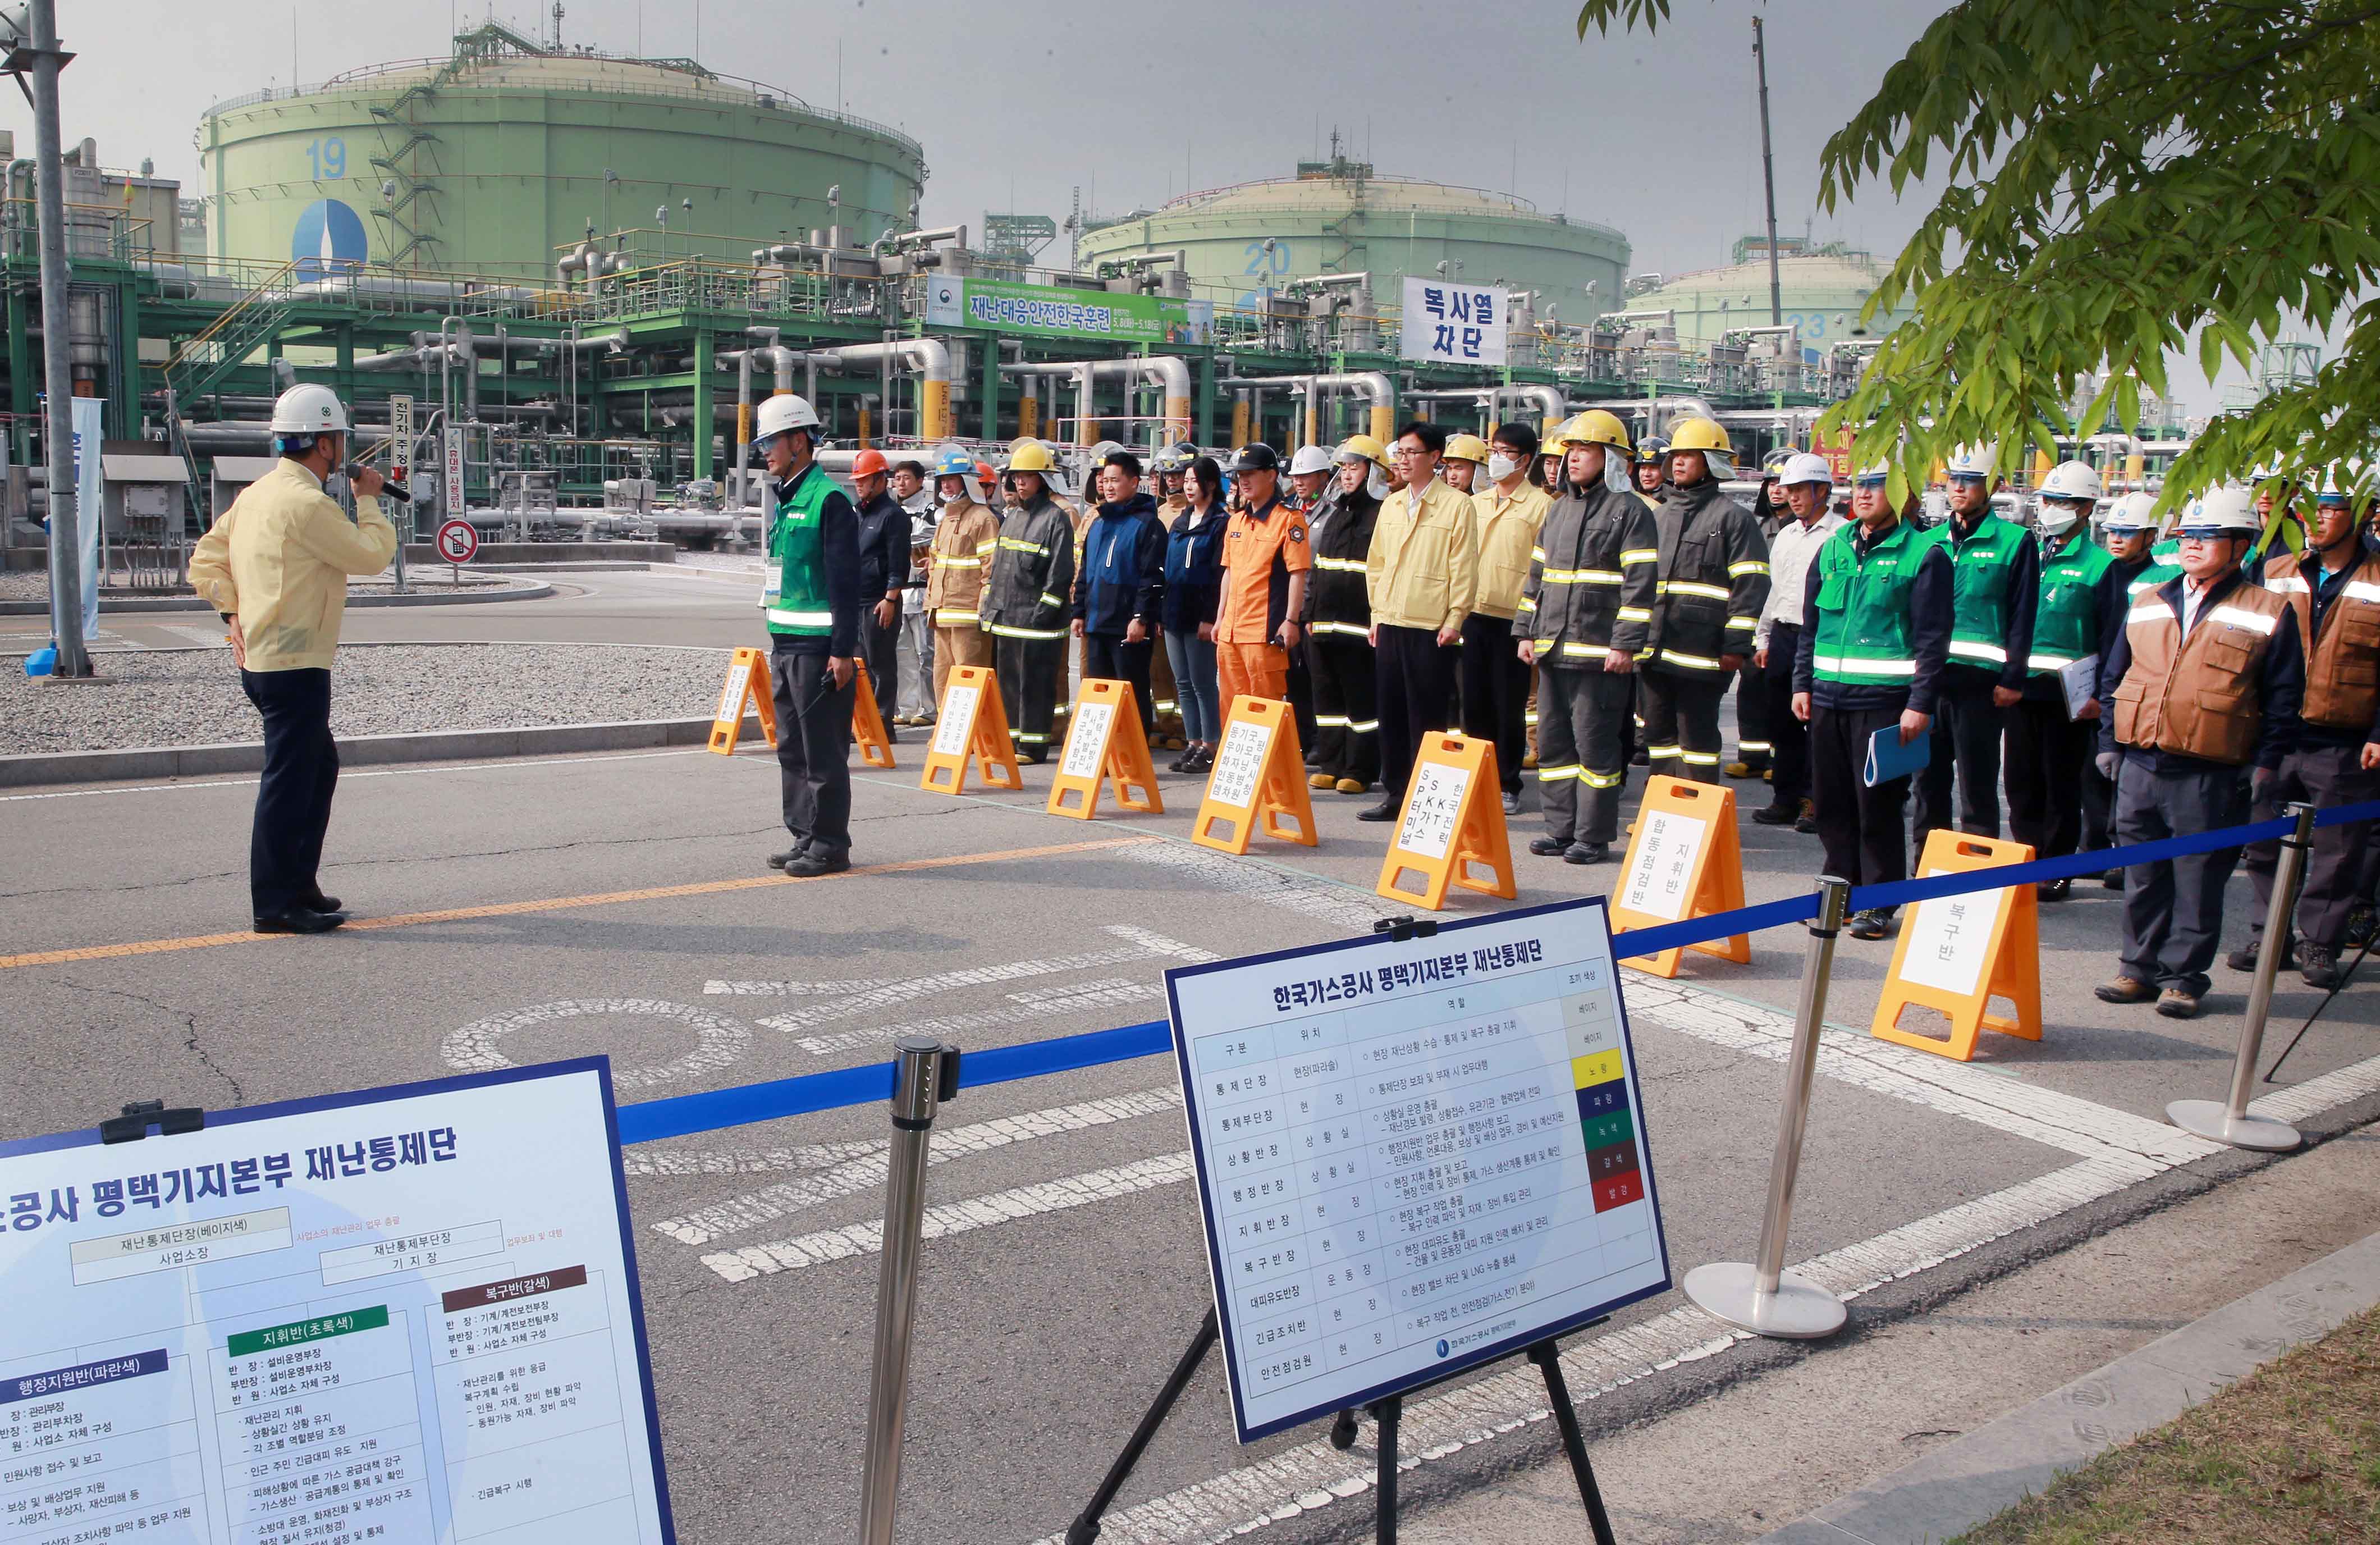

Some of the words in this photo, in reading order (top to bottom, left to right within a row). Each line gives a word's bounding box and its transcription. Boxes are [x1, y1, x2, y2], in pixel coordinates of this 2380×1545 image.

[305, 137, 346, 180] 19
[1244, 243, 1291, 276] 20
[970, 295, 1110, 332] 재난대응안전한국훈련
[1425, 287, 1492, 324] 복사열
[1433, 324, 1482, 358] 차단
[1787, 313, 1825, 339] 23
[396, 403, 409, 435] 전기차
[448, 450, 459, 474] 휴대폰
[450, 477, 460, 509] 사용금지
[1221, 729, 1249, 799] 기아자동차
[1231, 730, 1258, 801] 굿모닝병원
[1243, 740, 1265, 796] 평택시청
[1631, 819, 1667, 906] 합동점검반
[1665, 844, 1690, 894] 지휘반
[1938, 903, 1966, 962] 복구반
[1273, 970, 1373, 1011] 한국가스공사
[1377, 952, 1468, 991] 평택기지본부
[1472, 939, 1542, 971] 재난통제단
[1293, 1059, 1338, 1078] 현장(파라솔)
[92, 1153, 292, 1217] 평택기지본부
[305, 1127, 456, 1180] 재난통제단
[121, 1218, 247, 1250] 재난통제단장(베이지색)
[373, 1231, 450, 1255] 재난통제부단장
[159, 1246, 208, 1265] 사업소장
[486, 1276, 550, 1299] 복구반(갈색)
[1250, 1284, 1299, 1308] 대피유도반장
[480, 1300, 548, 1322] 기계/계전보전부장
[263, 1315, 353, 1345] 지휘반(초록색)
[448, 1330, 472, 1343] 부반장
[482, 1311, 558, 1336] 기계/계전보전팀부장
[483, 1337, 507, 1350] 사업소
[511, 1332, 527, 1343] 자체
[530, 1328, 546, 1340] 구성
[267, 1347, 321, 1368] 설비운영부장
[18, 1358, 139, 1395] 행정지원반(파란색)
[231, 1375, 258, 1390] 부반장
[269, 1360, 331, 1382] 설비운영부차장
[269, 1383, 297, 1396] 사업소
[300, 1378, 318, 1389] 자체
[322, 1373, 340, 1386] 구성
[463, 1371, 504, 1388] 재난관리를
[509, 1366, 525, 1378] 위한
[530, 1361, 546, 1374] 응급
[464, 1386, 498, 1401] 복구계획
[502, 1382, 519, 1393] 수립
[29, 1401, 64, 1418] 관리부장
[33, 1412, 83, 1432] 관리부차장
[244, 1409, 280, 1425] 재난관리
[285, 1404, 302, 1416] 지휘
[33, 1432, 63, 1446] 사업소
[68, 1426, 88, 1439] 자체
[92, 1421, 112, 1434] 구성
[251, 1423, 287, 1439] 상황실간
[291, 1418, 309, 1430] 상황
[313, 1413, 331, 1425] 유지
[253, 1443, 262, 1453] 각
[267, 1438, 284, 1450] 조별
[289, 1429, 323, 1445] 역할분담
[328, 1424, 346, 1437] 조정
[4, 1465, 42, 1483] 민원사항
[47, 1460, 66, 1473] 접수
[69, 1457, 79, 1468] 및
[83, 1452, 102, 1464] 보고
[250, 1464, 268, 1477] 인근
[273, 1459, 290, 1471] 주민
[295, 1450, 330, 1466] 긴급대피
[334, 1445, 352, 1457] 유도
[359, 1438, 377, 1450] 지원
[253, 1479, 298, 1497] 피해상황에
[302, 1474, 319, 1485] 따른
[324, 1470, 341, 1481] 가스
[345, 1459, 380, 1477] 공급대책
[384, 1455, 401, 1467] 강구
[478, 1483, 511, 1500] 긴급복구
[516, 1477, 532, 1489] 시행
[7, 1500, 26, 1513] 보상
[30, 1496, 40, 1508] 및
[44, 1487, 82, 1503] 배상업무
[86, 1482, 105, 1493] 지원
[18, 1510, 50, 1525] 사망자,
[53, 1502, 85, 1517] 부상자,
[89, 1492, 126, 1509] 재산피해
[129, 1489, 139, 1500] 등
